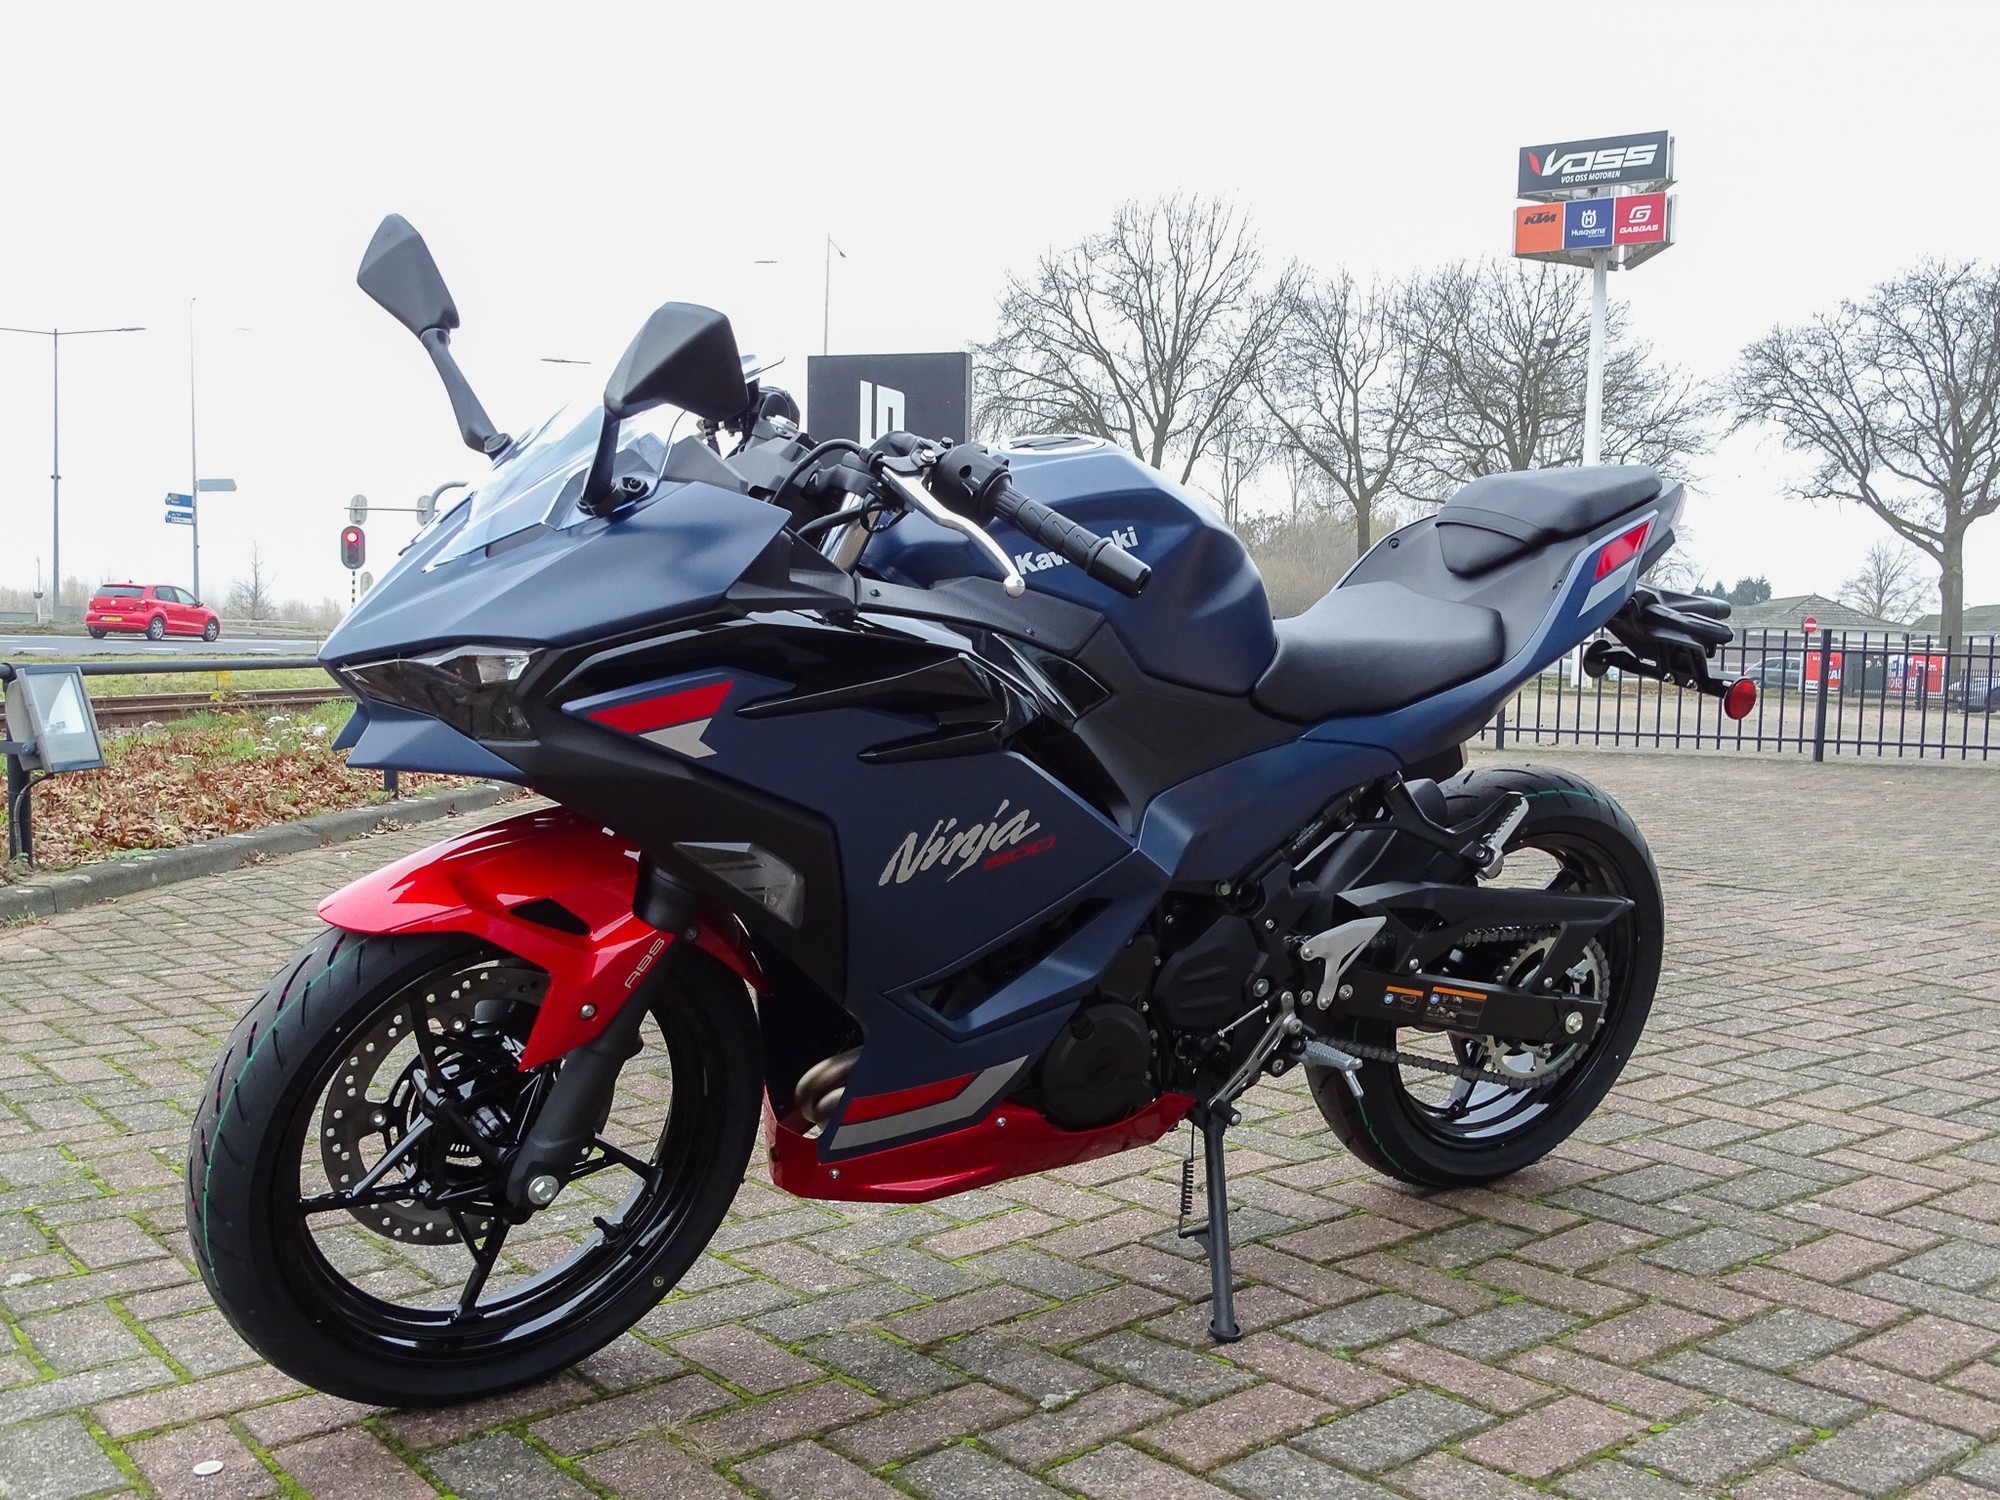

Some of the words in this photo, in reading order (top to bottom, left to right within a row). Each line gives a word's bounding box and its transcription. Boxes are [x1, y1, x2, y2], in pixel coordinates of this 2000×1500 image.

[1541, 144, 1658, 176] VOSS
[1561, 174, 1574, 184] VOS
[1575, 173, 1588, 182] OSS
[1588, 170, 1621, 180] MOTOREN
[1524, 212, 1557, 225] KTM
[1619, 224, 1659, 234] GASGAS
[1571, 228, 1606, 237] Husqvarna
[1014, 525, 1139, 575] Kawki
[878, 799, 1041, 886] Ninja
[984, 836, 1056, 870] 500
[624, 937, 665, 989] ABS
